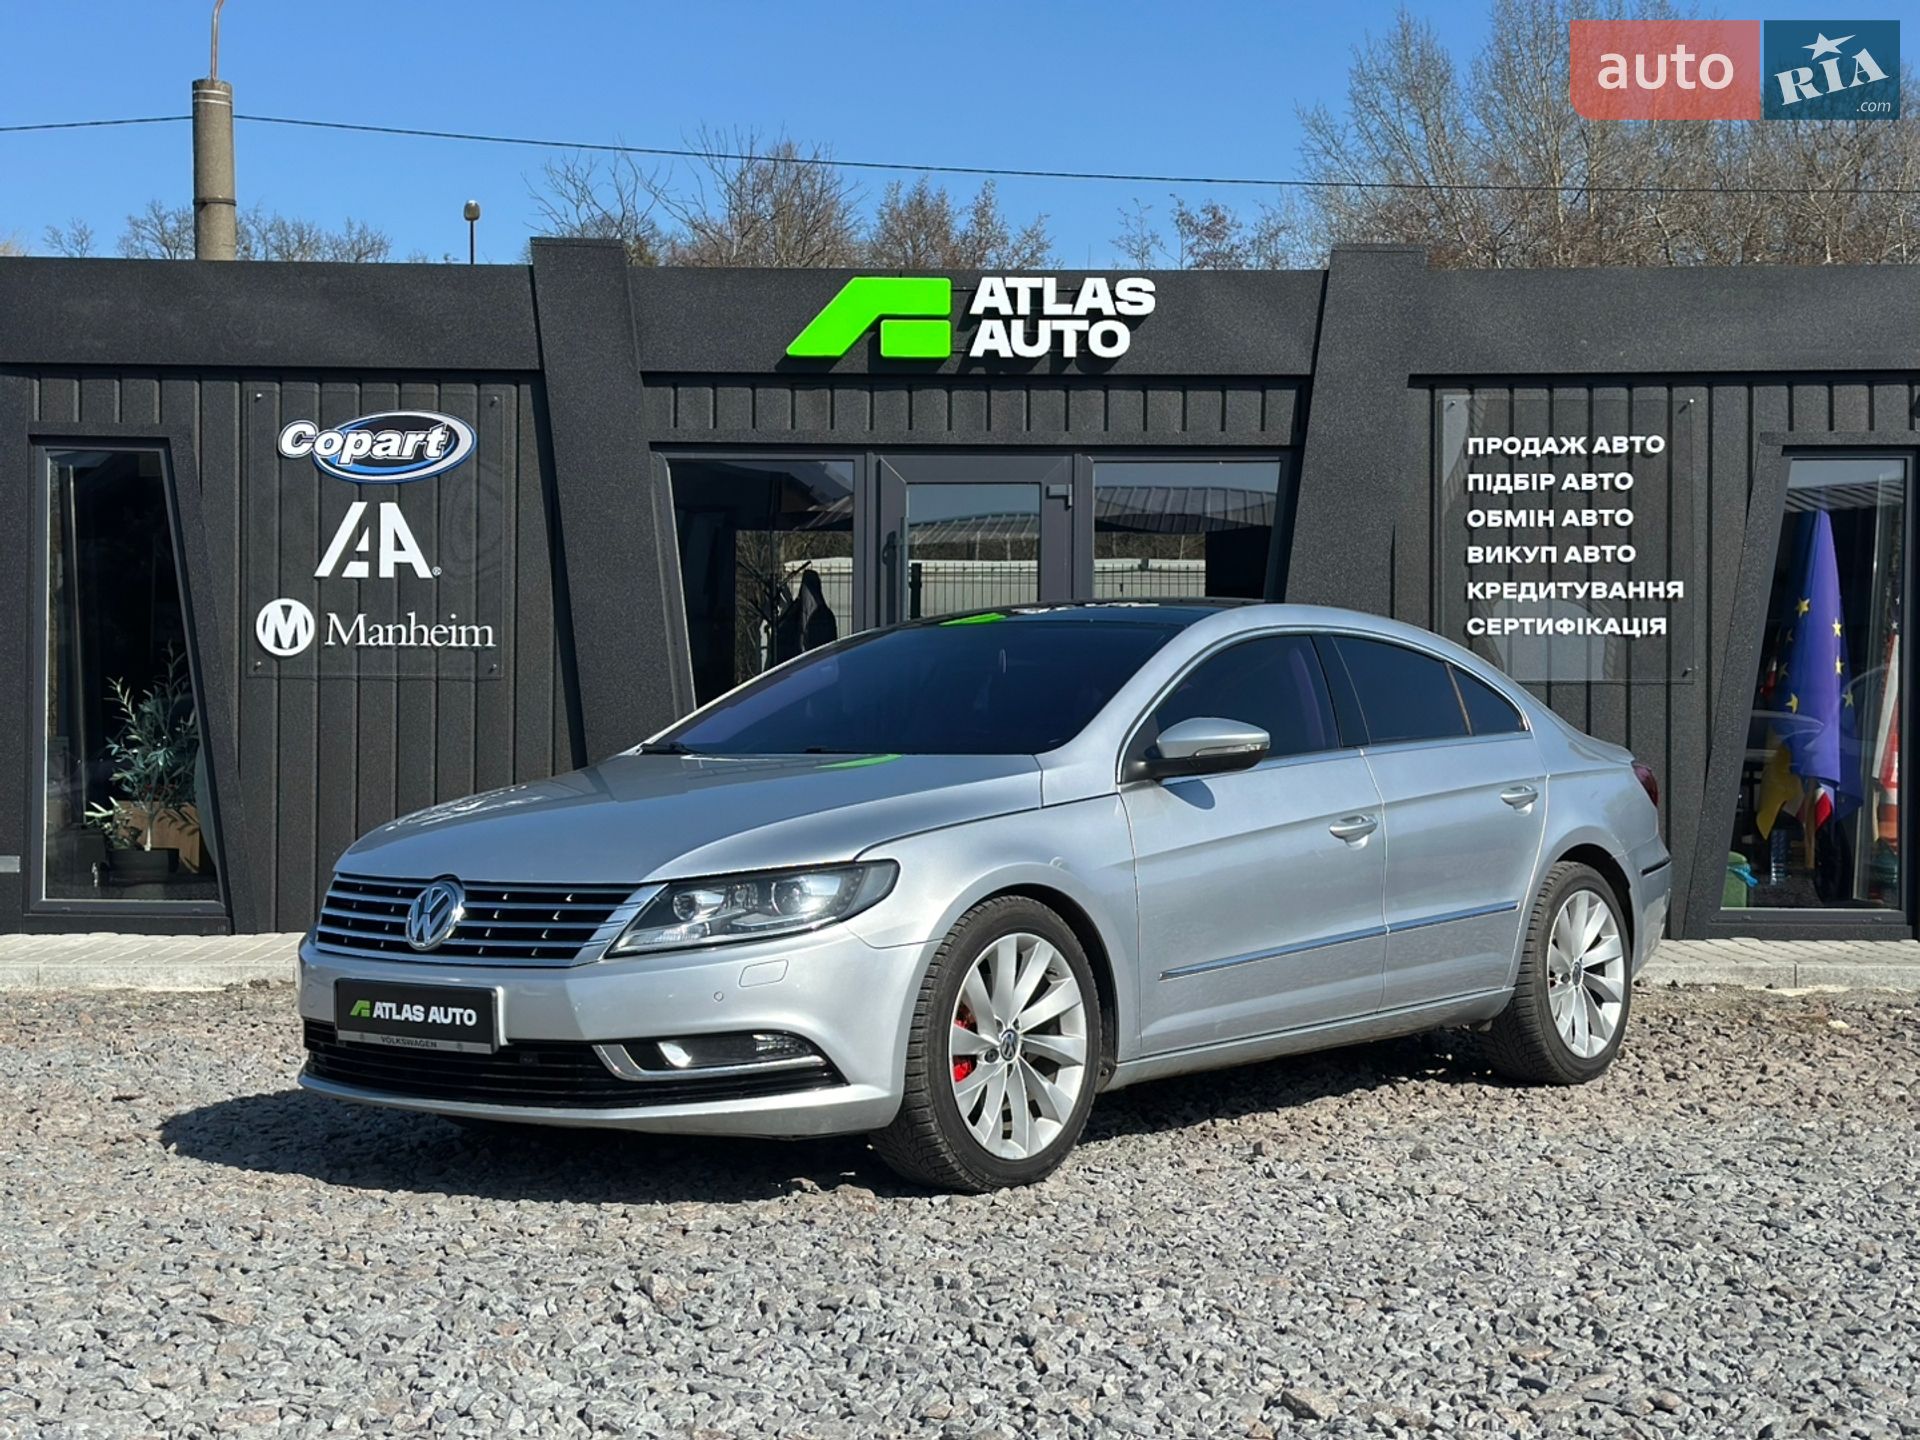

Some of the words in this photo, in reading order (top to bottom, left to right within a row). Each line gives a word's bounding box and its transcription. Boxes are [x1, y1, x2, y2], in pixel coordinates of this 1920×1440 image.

[968, 276, 1156, 316] ATLAS
[968, 319, 1131, 359] AUTO
[278, 419, 449, 466] Copart
[1467, 436, 1588, 458] ПРОДАЖ
[1592, 435, 1666, 454] АВТО
[1467, 473, 1556, 495] ПІДБІР
[1561, 471, 1635, 491] АВТО
[1466, 509, 1555, 528] ОБМІН
[1561, 508, 1635, 527] АВТО
[1467, 545, 1557, 564] ВИКУП
[1563, 545, 1637, 563] АВТО
[1467, 581, 1685, 602] КРЕДИТУВАННЯ
[324, 611, 497, 647] Manheim
[1466, 617, 1668, 638] СЕРТИФІКАЦІЯ
[372, 1001, 425, 1023] ATLAS
[427, 1007, 477, 1027] AUTO
[380, 1036, 437, 1049] VOLKSWAGEN
